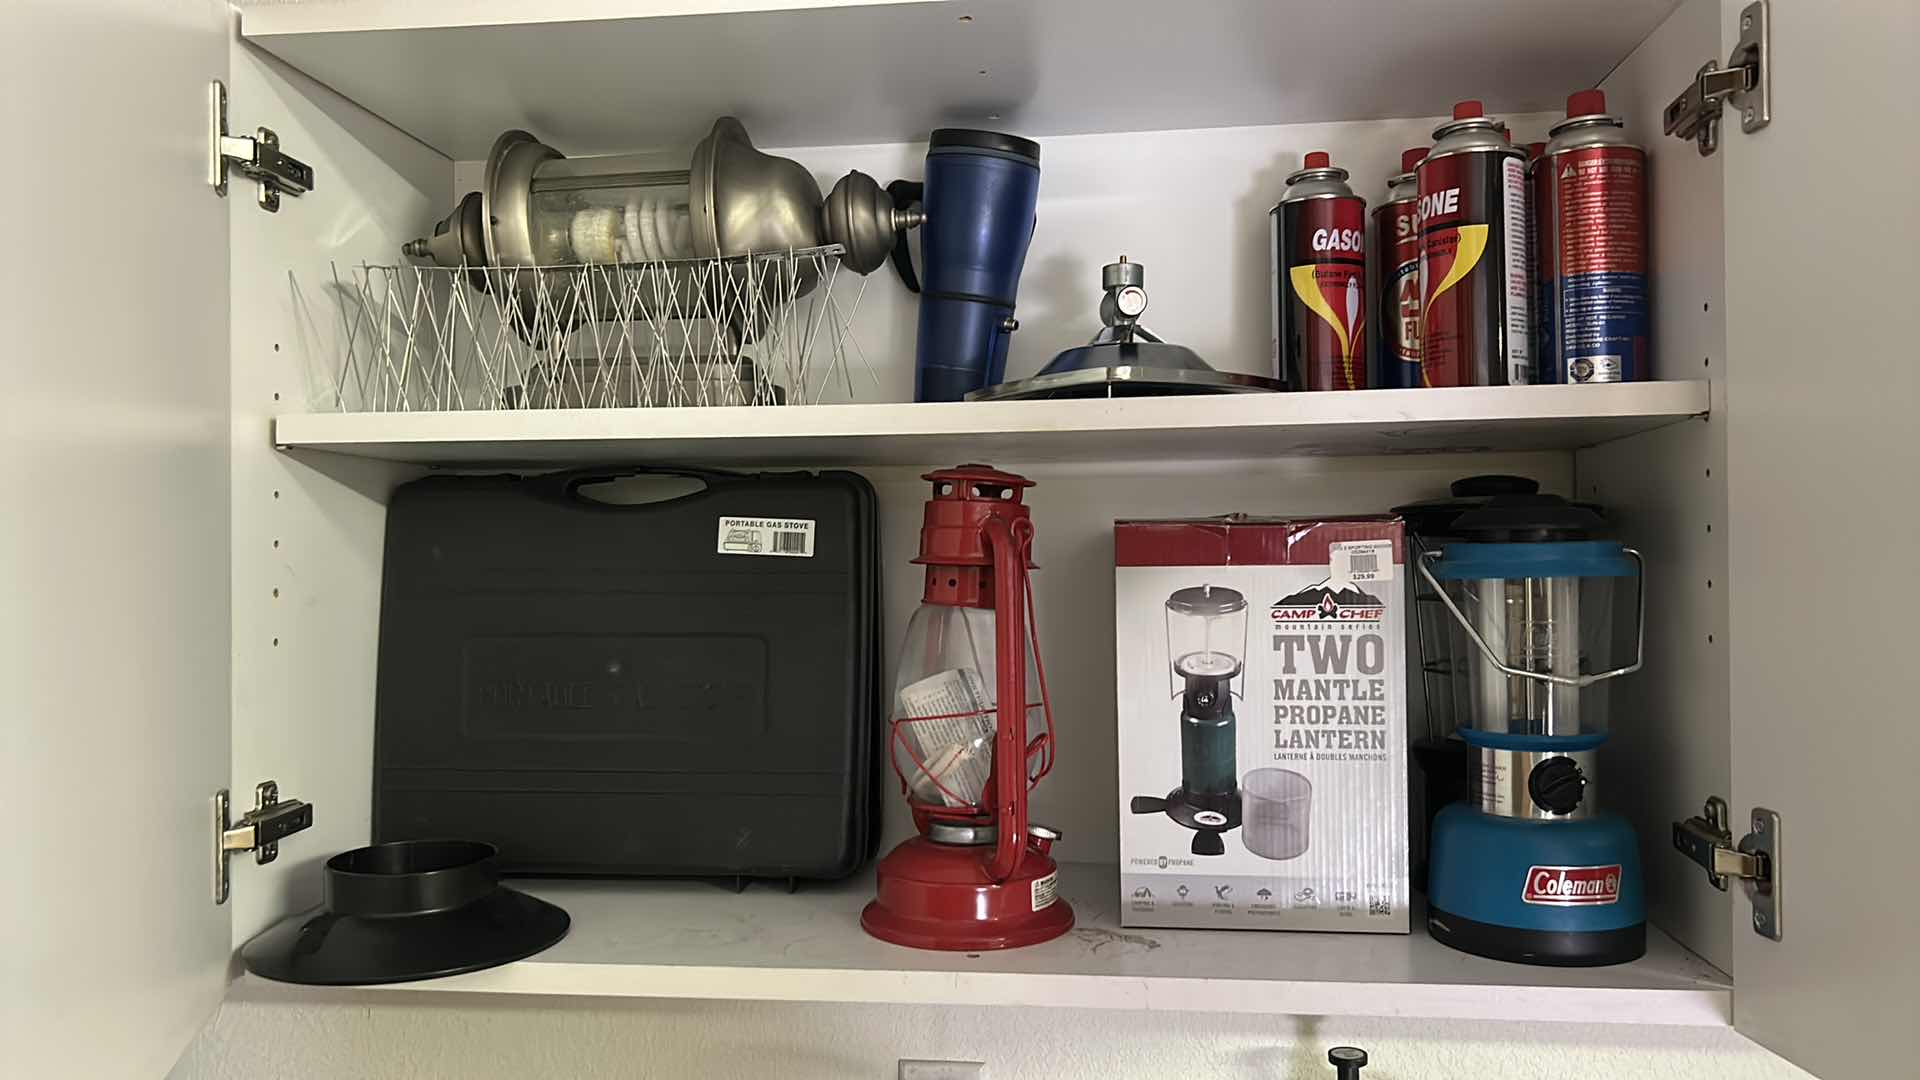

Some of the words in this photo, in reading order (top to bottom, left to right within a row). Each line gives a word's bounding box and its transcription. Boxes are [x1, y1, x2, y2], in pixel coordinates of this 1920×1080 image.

[1312, 228, 1364, 253] GASO
[725, 520, 763, 528] PORTABLE
[784, 522, 809, 530] STOVE
[1271, 609, 1316, 619] CAMP
[1339, 609, 1384, 619] CHEF
[1273, 634, 1384, 675] TWO
[1273, 679, 1385, 701] MANTLE
[1274, 705, 1386, 725] PROPANE
[1274, 730, 1386, 749] LANTERN
[1309, 752, 1315, 760] À
[1534, 871, 1604, 895] Coleman
